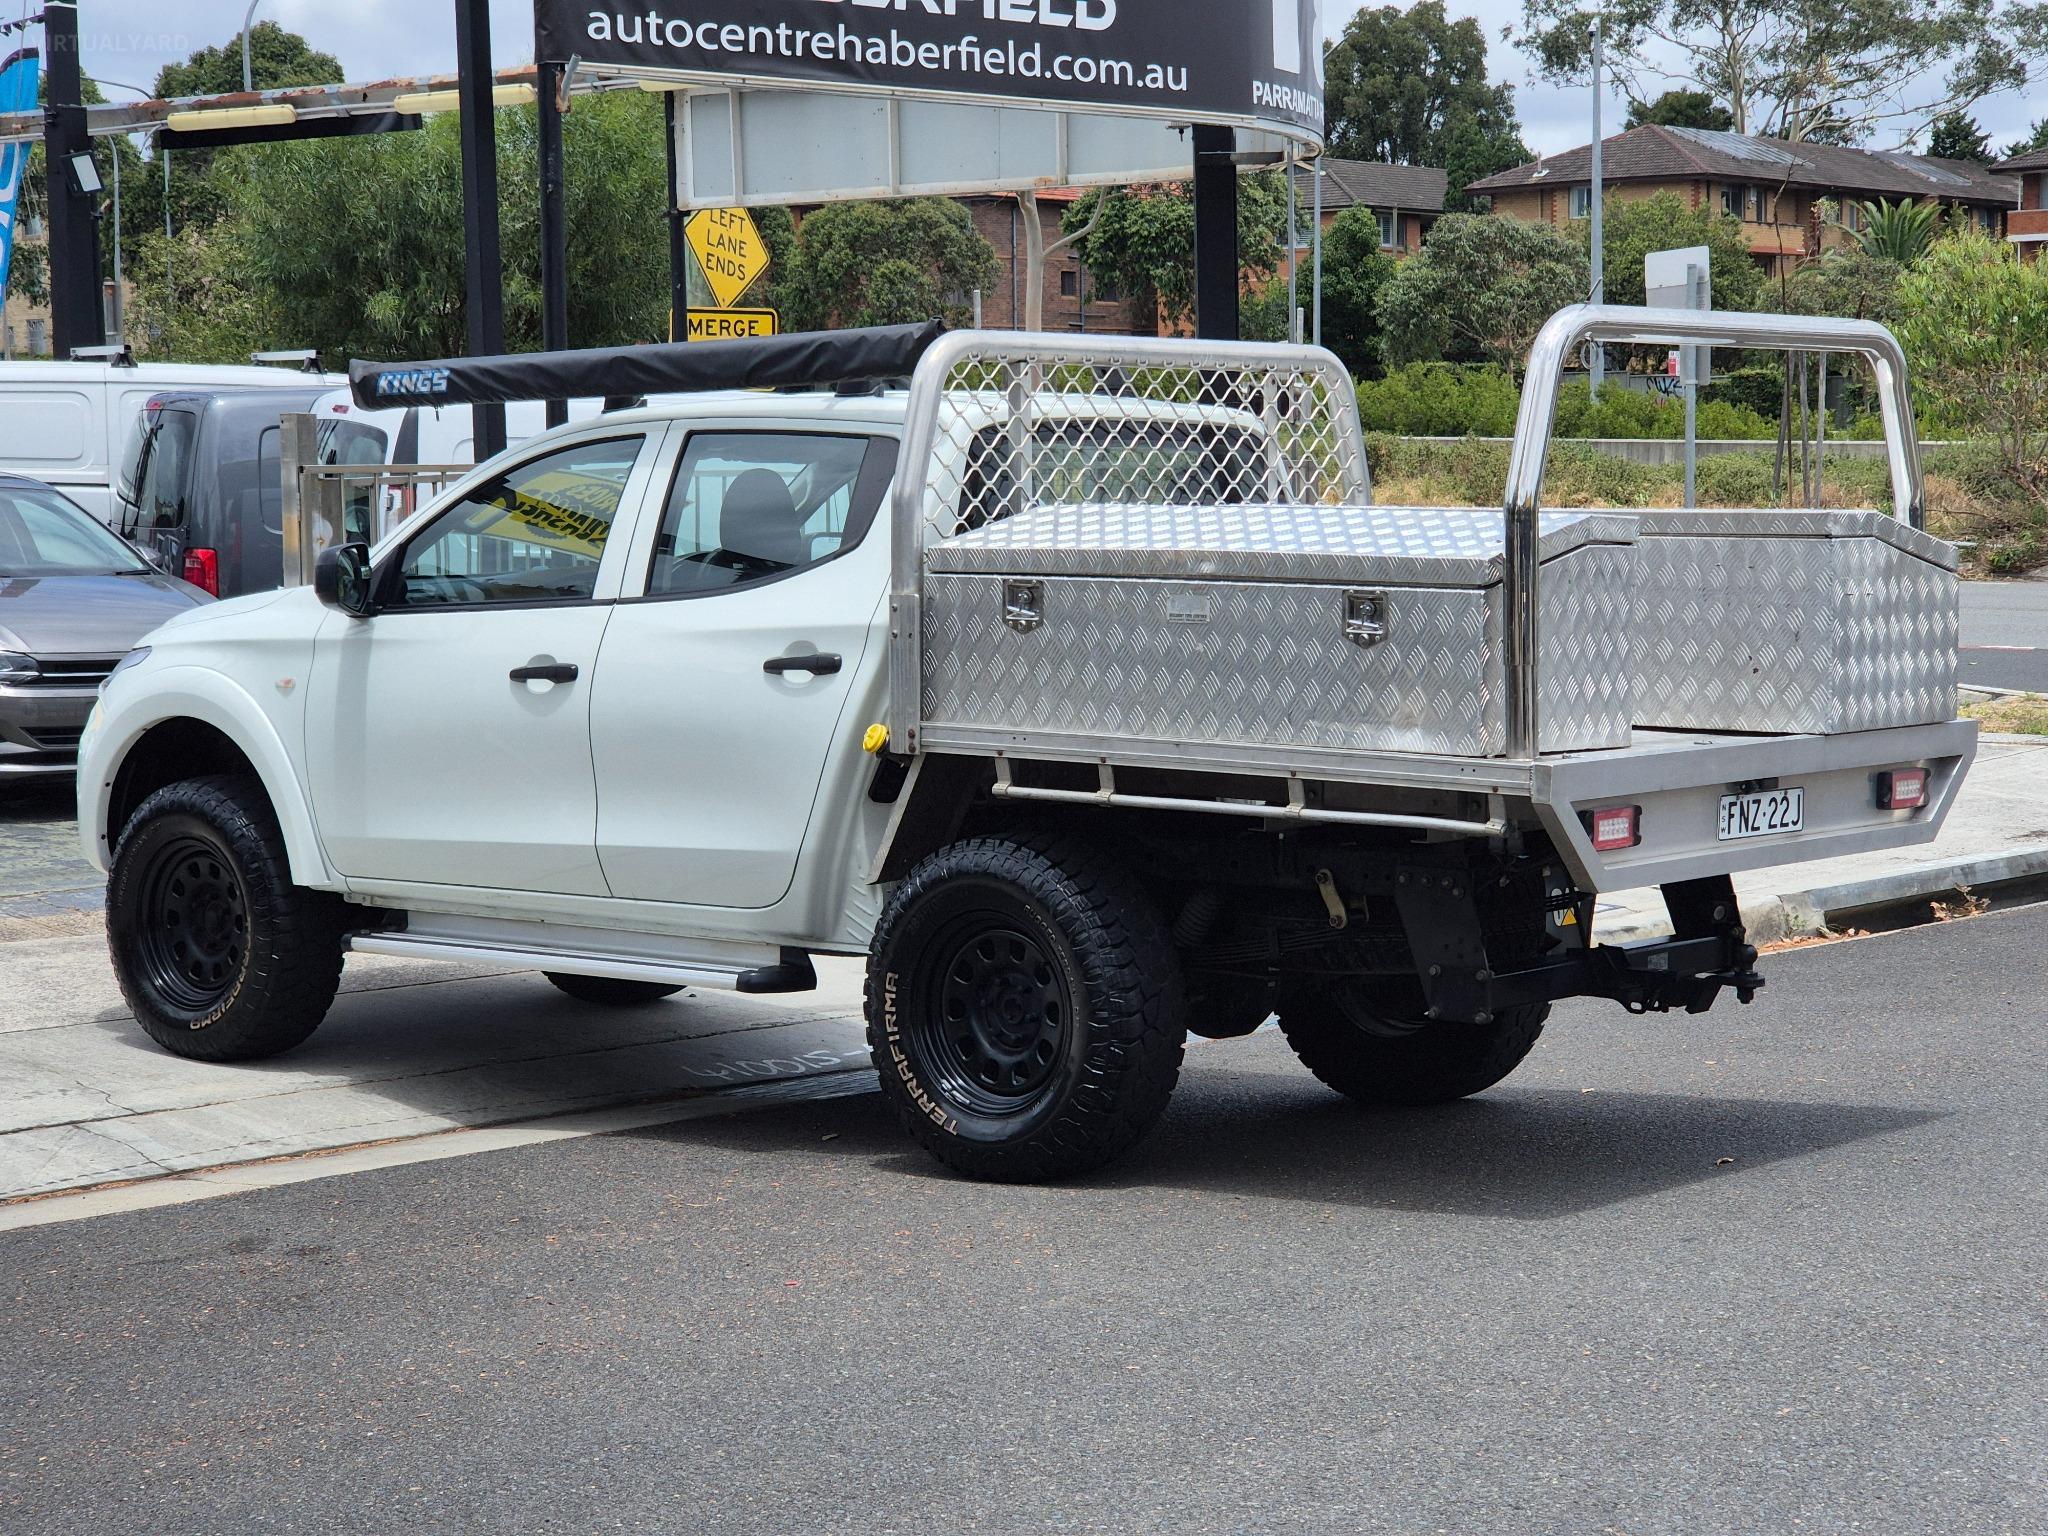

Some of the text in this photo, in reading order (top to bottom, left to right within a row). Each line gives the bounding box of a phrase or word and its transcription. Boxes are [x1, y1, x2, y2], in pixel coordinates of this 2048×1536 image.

[587, 10, 1188, 92] autocentrehaberfield.com.au
[709, 208, 746, 234] LEFT
[706, 228, 747, 258] LANE
[705, 252, 746, 281] ENDS
[688, 318, 760, 337] MERGE
[377, 369, 451, 394] KINGS
[884, 971, 959, 1136] TERRAFIRMA
